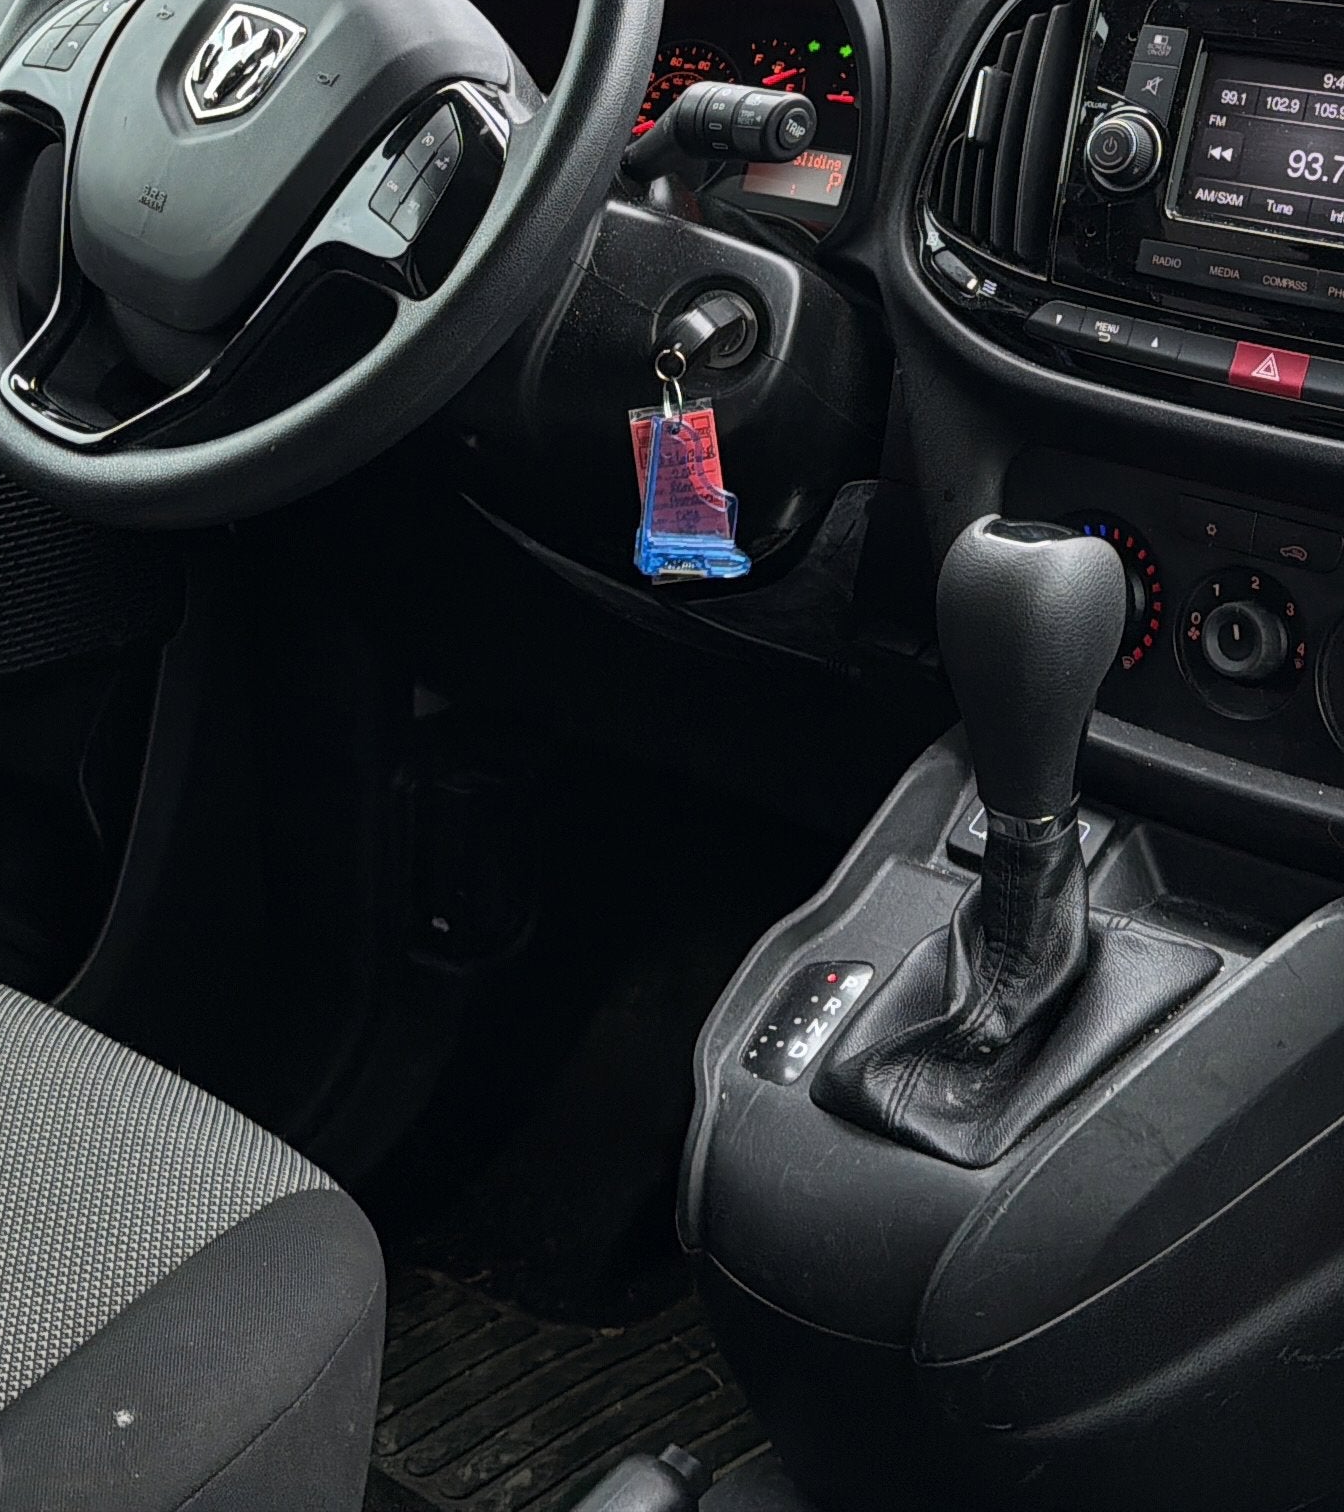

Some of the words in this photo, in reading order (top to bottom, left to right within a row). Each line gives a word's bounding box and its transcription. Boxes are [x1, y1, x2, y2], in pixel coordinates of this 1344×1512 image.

[1220, 89, 1247, 106] 99.1
[1266, 95, 1300, 114] 102.9
[785, 118, 806, 138] TRIP
[1208, 114, 1227, 127] FM
[1194, 187, 1244, 207] AM/SXM
[1266, 198, 1294, 216] Tune
[1151, 254, 1182, 269] RADIO
[1208, 265, 1240, 280] MEDIA
[1262, 274, 1309, 292] COMPASS
[1094, 320, 1120, 335] MENU
[1212, 583, 1220, 597] 1
[1251, 575, 1260, 590] 2
[1286, 602, 1295, 617] 3
[1296, 642, 1305, 657] 4
[839, 974, 858, 991] P
[822, 996, 843, 1016] R
[805, 1018, 829, 1038] N
[788, 1040, 808, 1059] D
